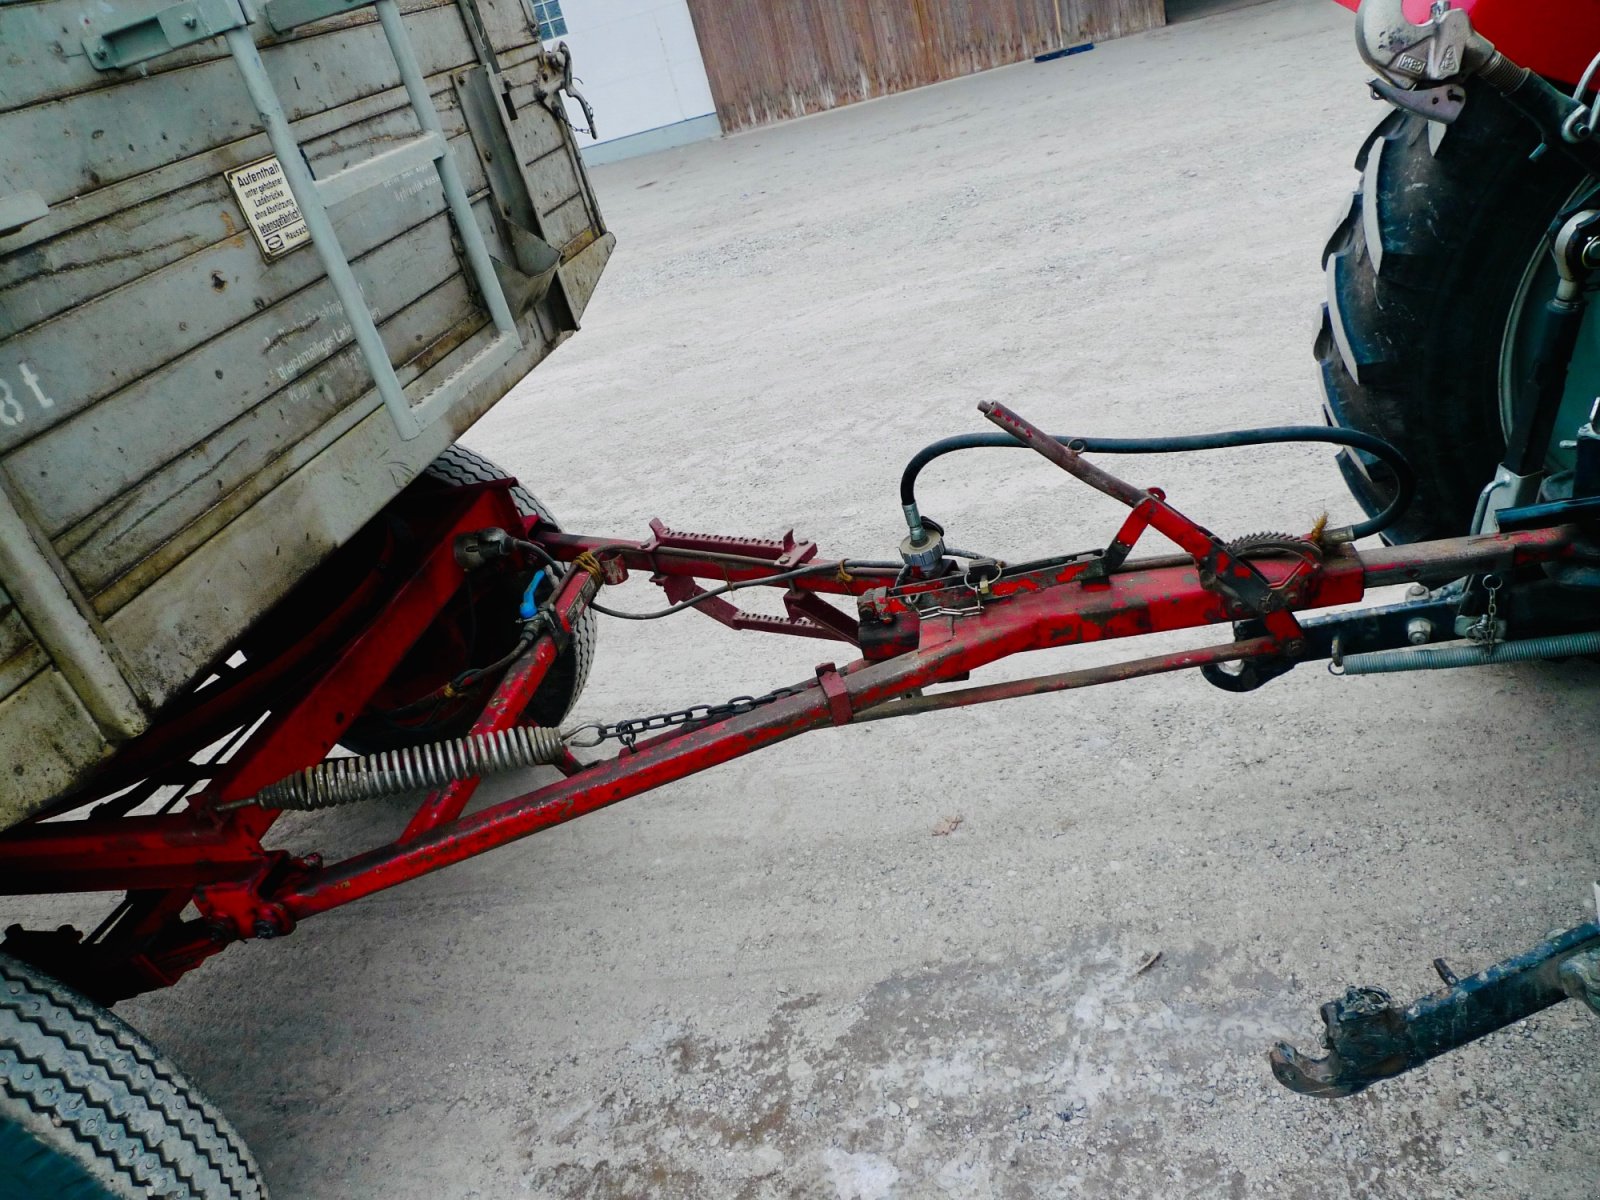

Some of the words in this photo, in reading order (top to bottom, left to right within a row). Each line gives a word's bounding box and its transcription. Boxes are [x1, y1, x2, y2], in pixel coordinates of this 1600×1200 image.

[237, 163, 280, 188] Aufenthalt
[244, 187, 259, 199] unter
[258, 177, 283, 195] gehobener
[253, 190, 285, 208] Ladebrücke
[254, 209, 267, 221] ohne
